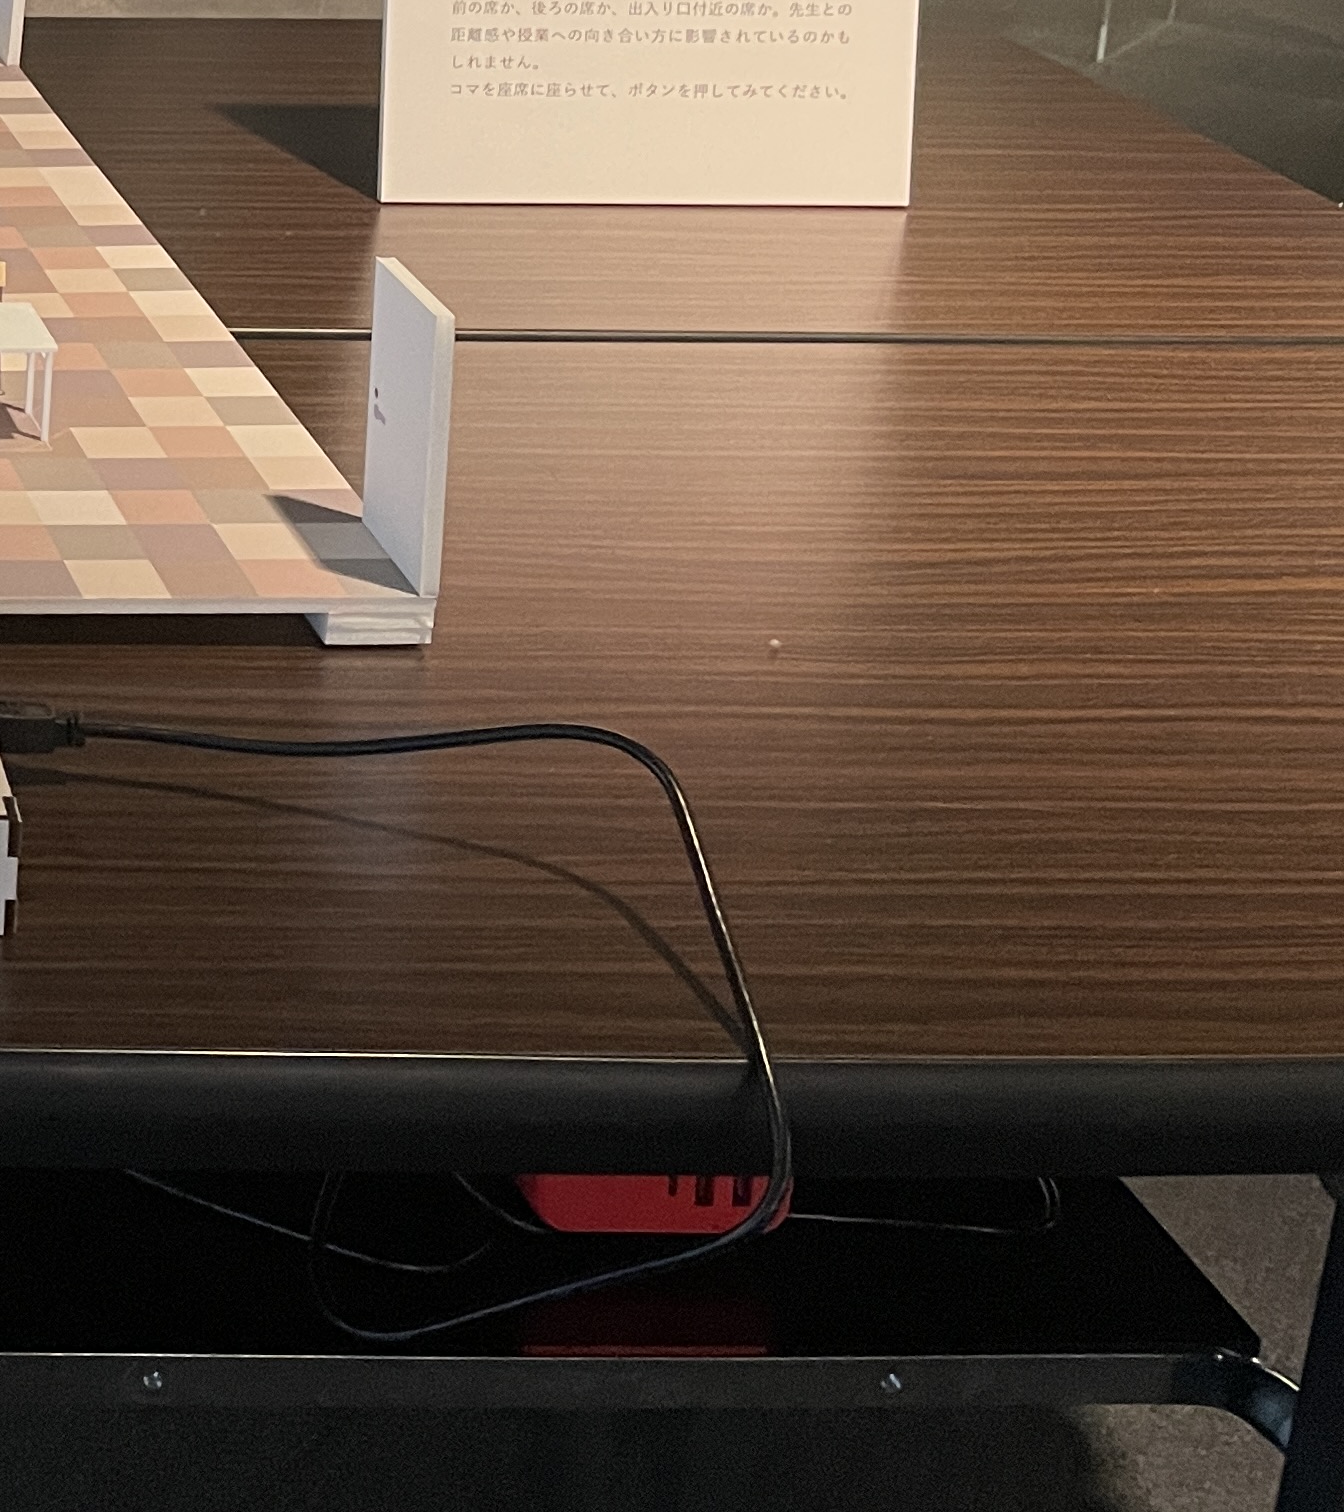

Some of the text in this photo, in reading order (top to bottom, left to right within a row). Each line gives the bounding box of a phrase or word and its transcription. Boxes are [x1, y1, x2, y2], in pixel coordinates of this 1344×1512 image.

[452, 0, 853, 18] 前の席か、後ろの席か、出入り口付近の席か。先生との
[450, 27, 851, 44] 距離感や授業への向き合い方に影響されているのかも
[452, 54, 540, 70] しれません。
[450, 82, 847, 100] コマを座席に座らせて、ボタンを押してみてください。
